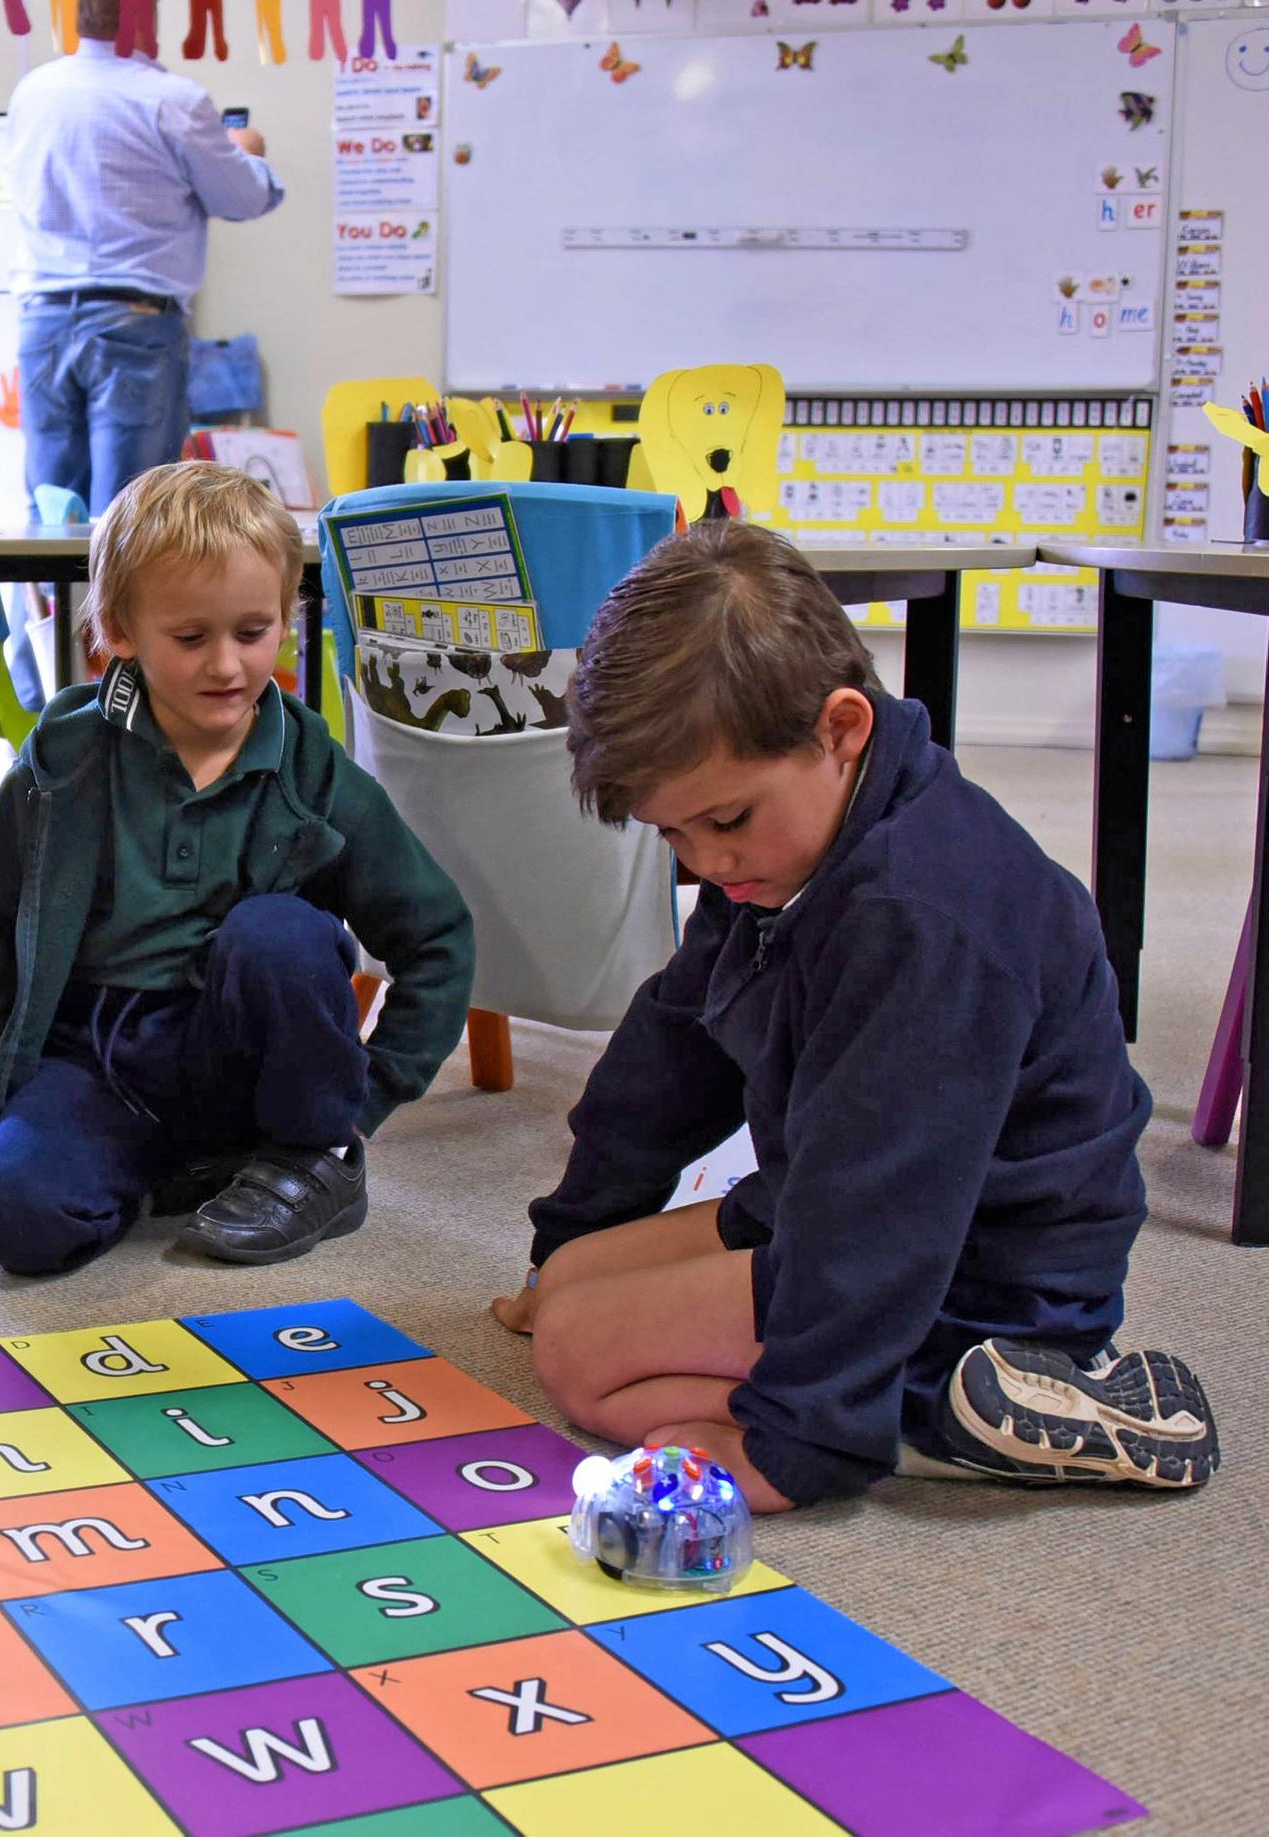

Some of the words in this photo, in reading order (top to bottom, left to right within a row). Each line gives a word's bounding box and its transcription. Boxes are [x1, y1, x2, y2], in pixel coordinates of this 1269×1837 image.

[352, 57, 378, 73] Do
[338, 140, 364, 154] We
[372, 138, 396, 154] Do
[1101, 199, 1114, 221] h
[1134, 203, 1156, 219] er
[337, 223, 372, 239] You
[379, 221, 407, 239] Do
[1060, 306, 1073, 328] h
[1093, 312, 1106, 328] o
[1120, 307, 1148, 323] me
[196, 1319, 214, 1328] E
[273, 1326, 342, 1353] e
[12, 1340, 30, 1350] D
[80, 1335, 169, 1377] d
[364, 1380, 427, 1424] j
[161, 1407, 235, 1448] i
[458, 1459, 538, 1493] o
[236, 1488, 353, 1528] n
[356, 1575, 440, 1619] s
[120, 1610, 184, 1659] r
[368, 1669, 402, 1686] X
[699, 1630, 847, 1706] y
[465, 1677, 594, 1737] x
[184, 1717, 340, 1785] w
